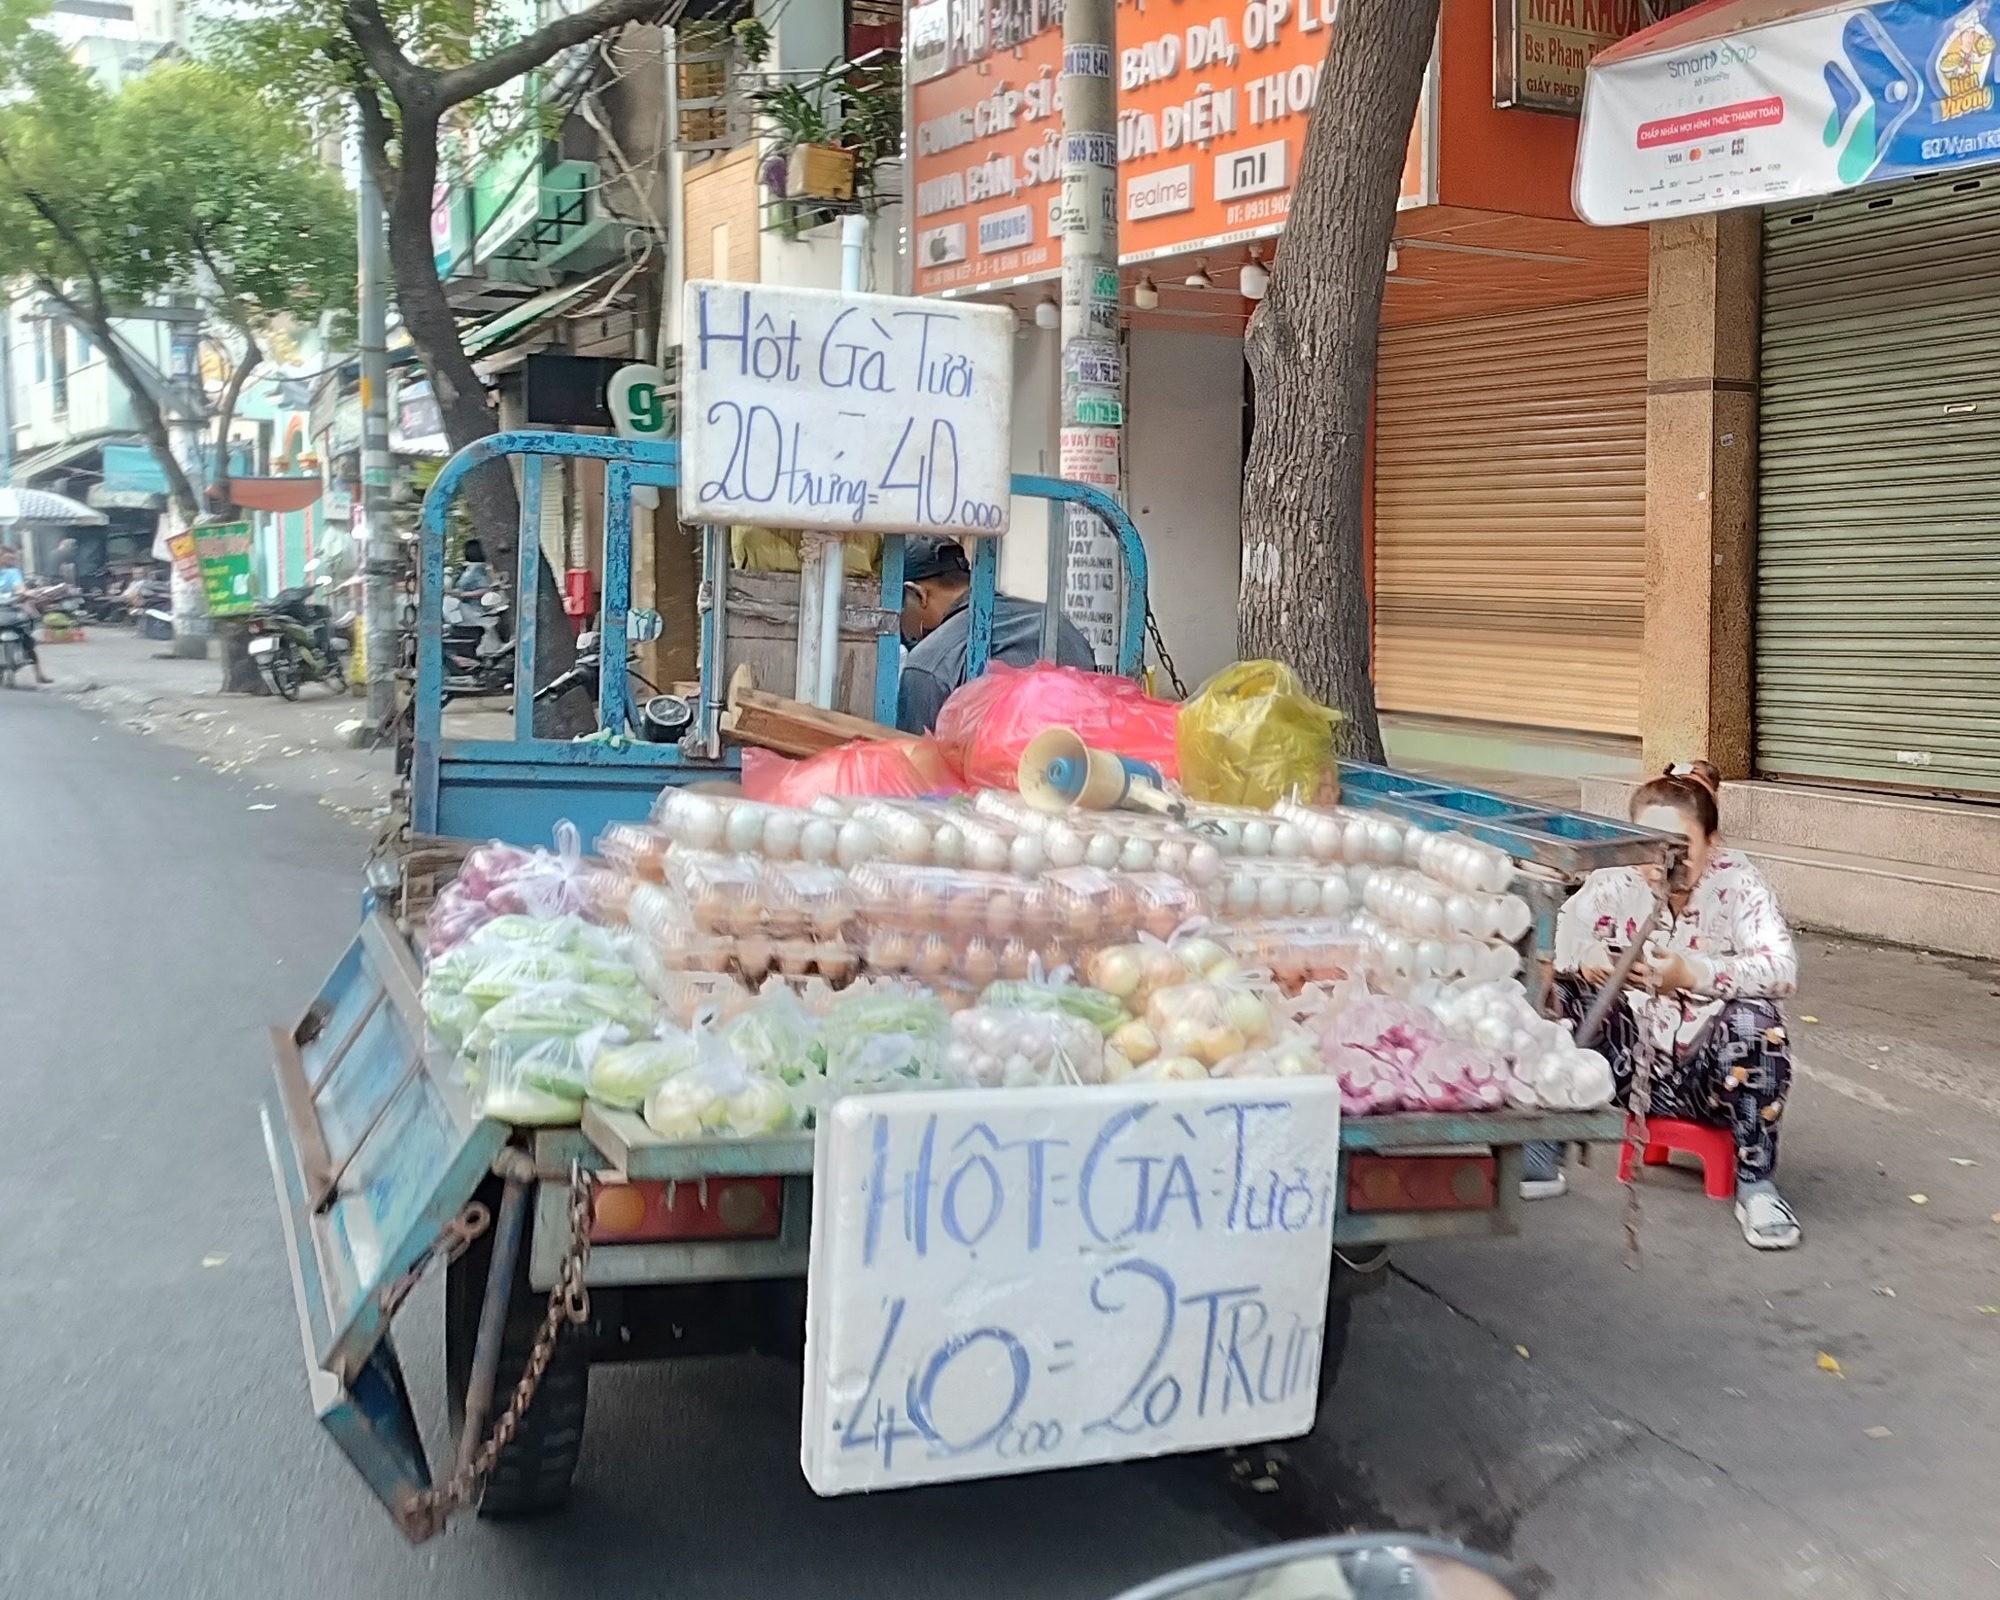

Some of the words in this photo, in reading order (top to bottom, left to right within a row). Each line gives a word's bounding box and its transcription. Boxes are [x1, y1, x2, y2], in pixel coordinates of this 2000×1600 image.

[1120, 33, 1181, 91] BAO
[1186, 16, 1239, 70] DA,
[1525, 34, 1545, 63] Bs:
[1548, 37, 1584, 75] Phạm
[1667, 52, 1710, 78] Smart
[1720, 44, 1757, 67] Shop
[1526, 75, 1552, 94] GIẤY
[975, 80, 1020, 138] CẤP
[1161, 82, 1237, 151] ĐIỆN
[1731, 110, 1757, 122] THANH
[1758, 105, 1780, 118] TOÁN
[1667, 153, 1683, 164] VISA
[1129, 181, 1188, 211] realme
[1244, 199, 1270, 221] 0931
[980, 215, 1026, 245] SAMSUNG
[699, 290, 801, 383] Hột
[819, 307, 896, 393] Gà
[628, 383, 663, 433] 9
[1072, 572, 1090, 591] 193
[1067, 593, 1094, 609] VAY
[1078, 1102, 1203, 1243] GÀ
